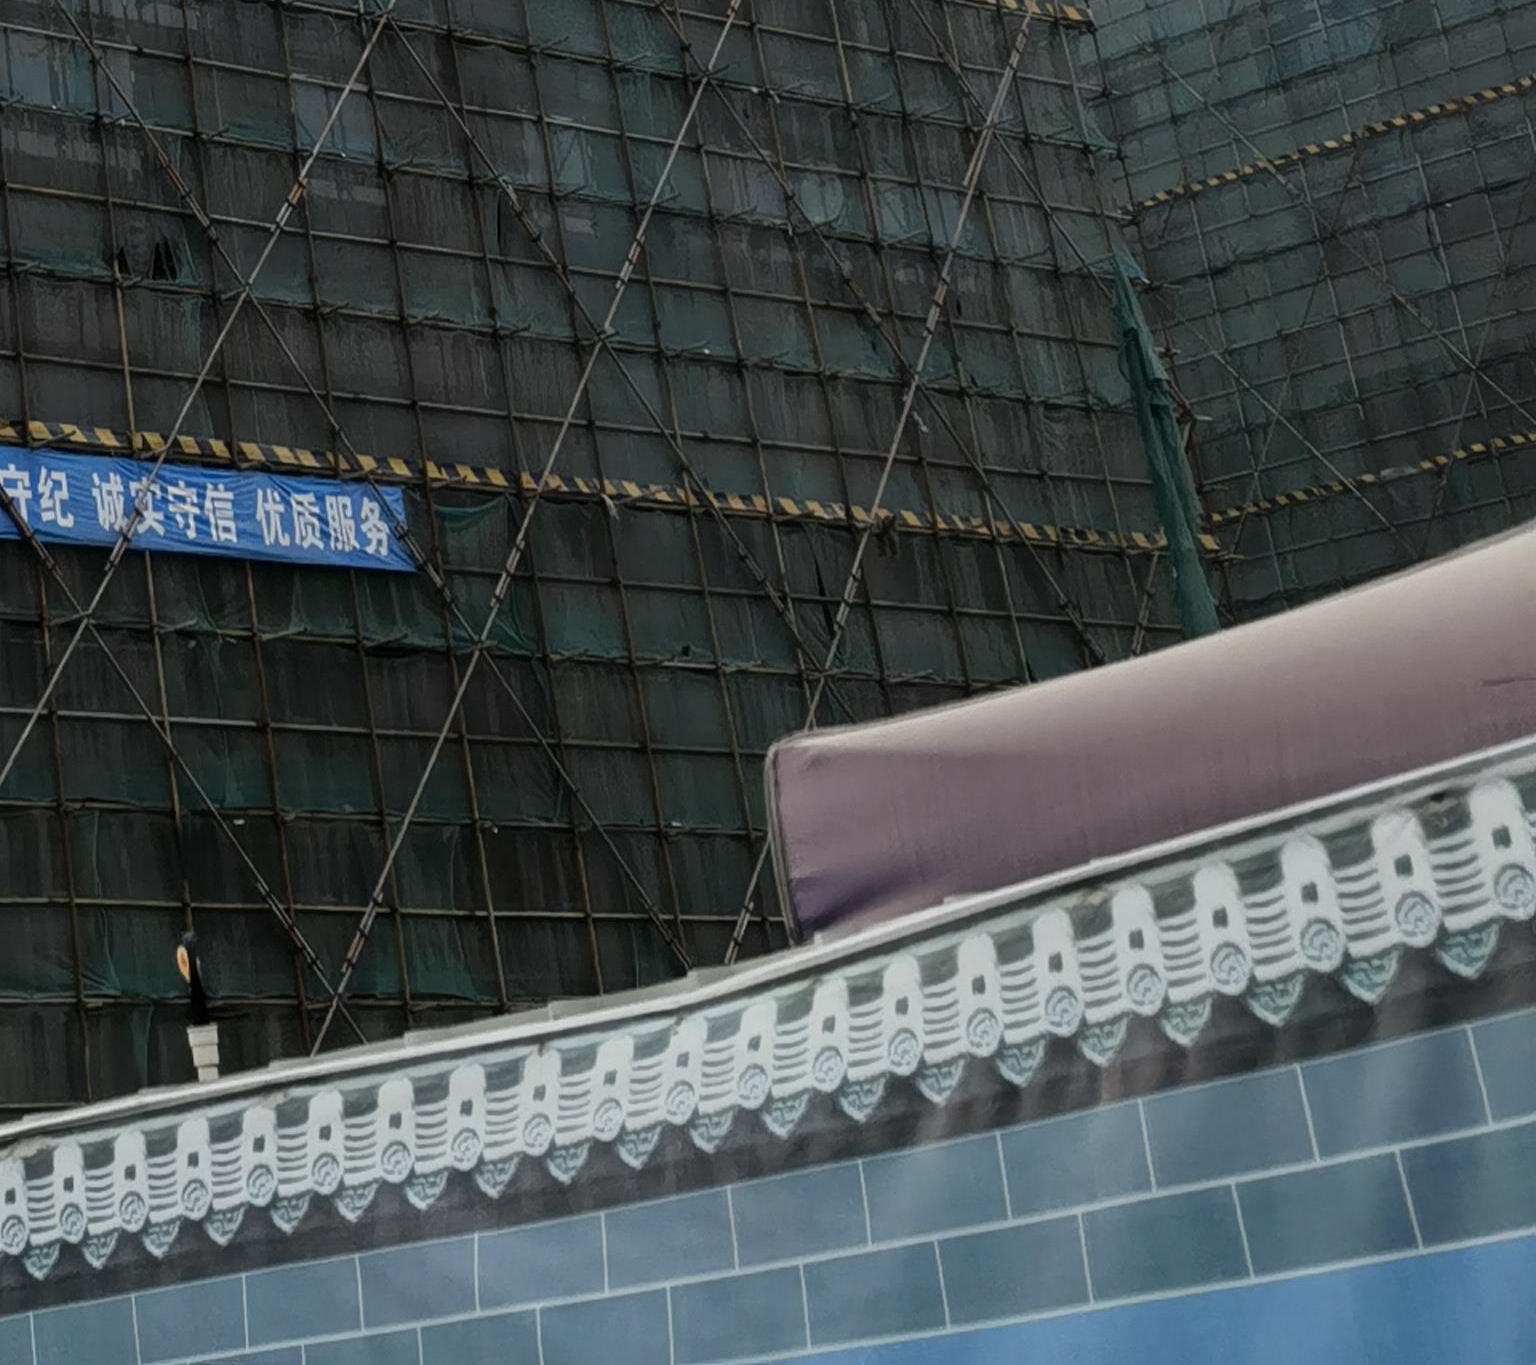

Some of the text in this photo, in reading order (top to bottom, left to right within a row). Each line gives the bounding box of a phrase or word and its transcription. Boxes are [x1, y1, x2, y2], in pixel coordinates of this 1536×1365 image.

[91, 470, 239, 545] 诚实守信
[255, 487, 391, 558] 优质服务
